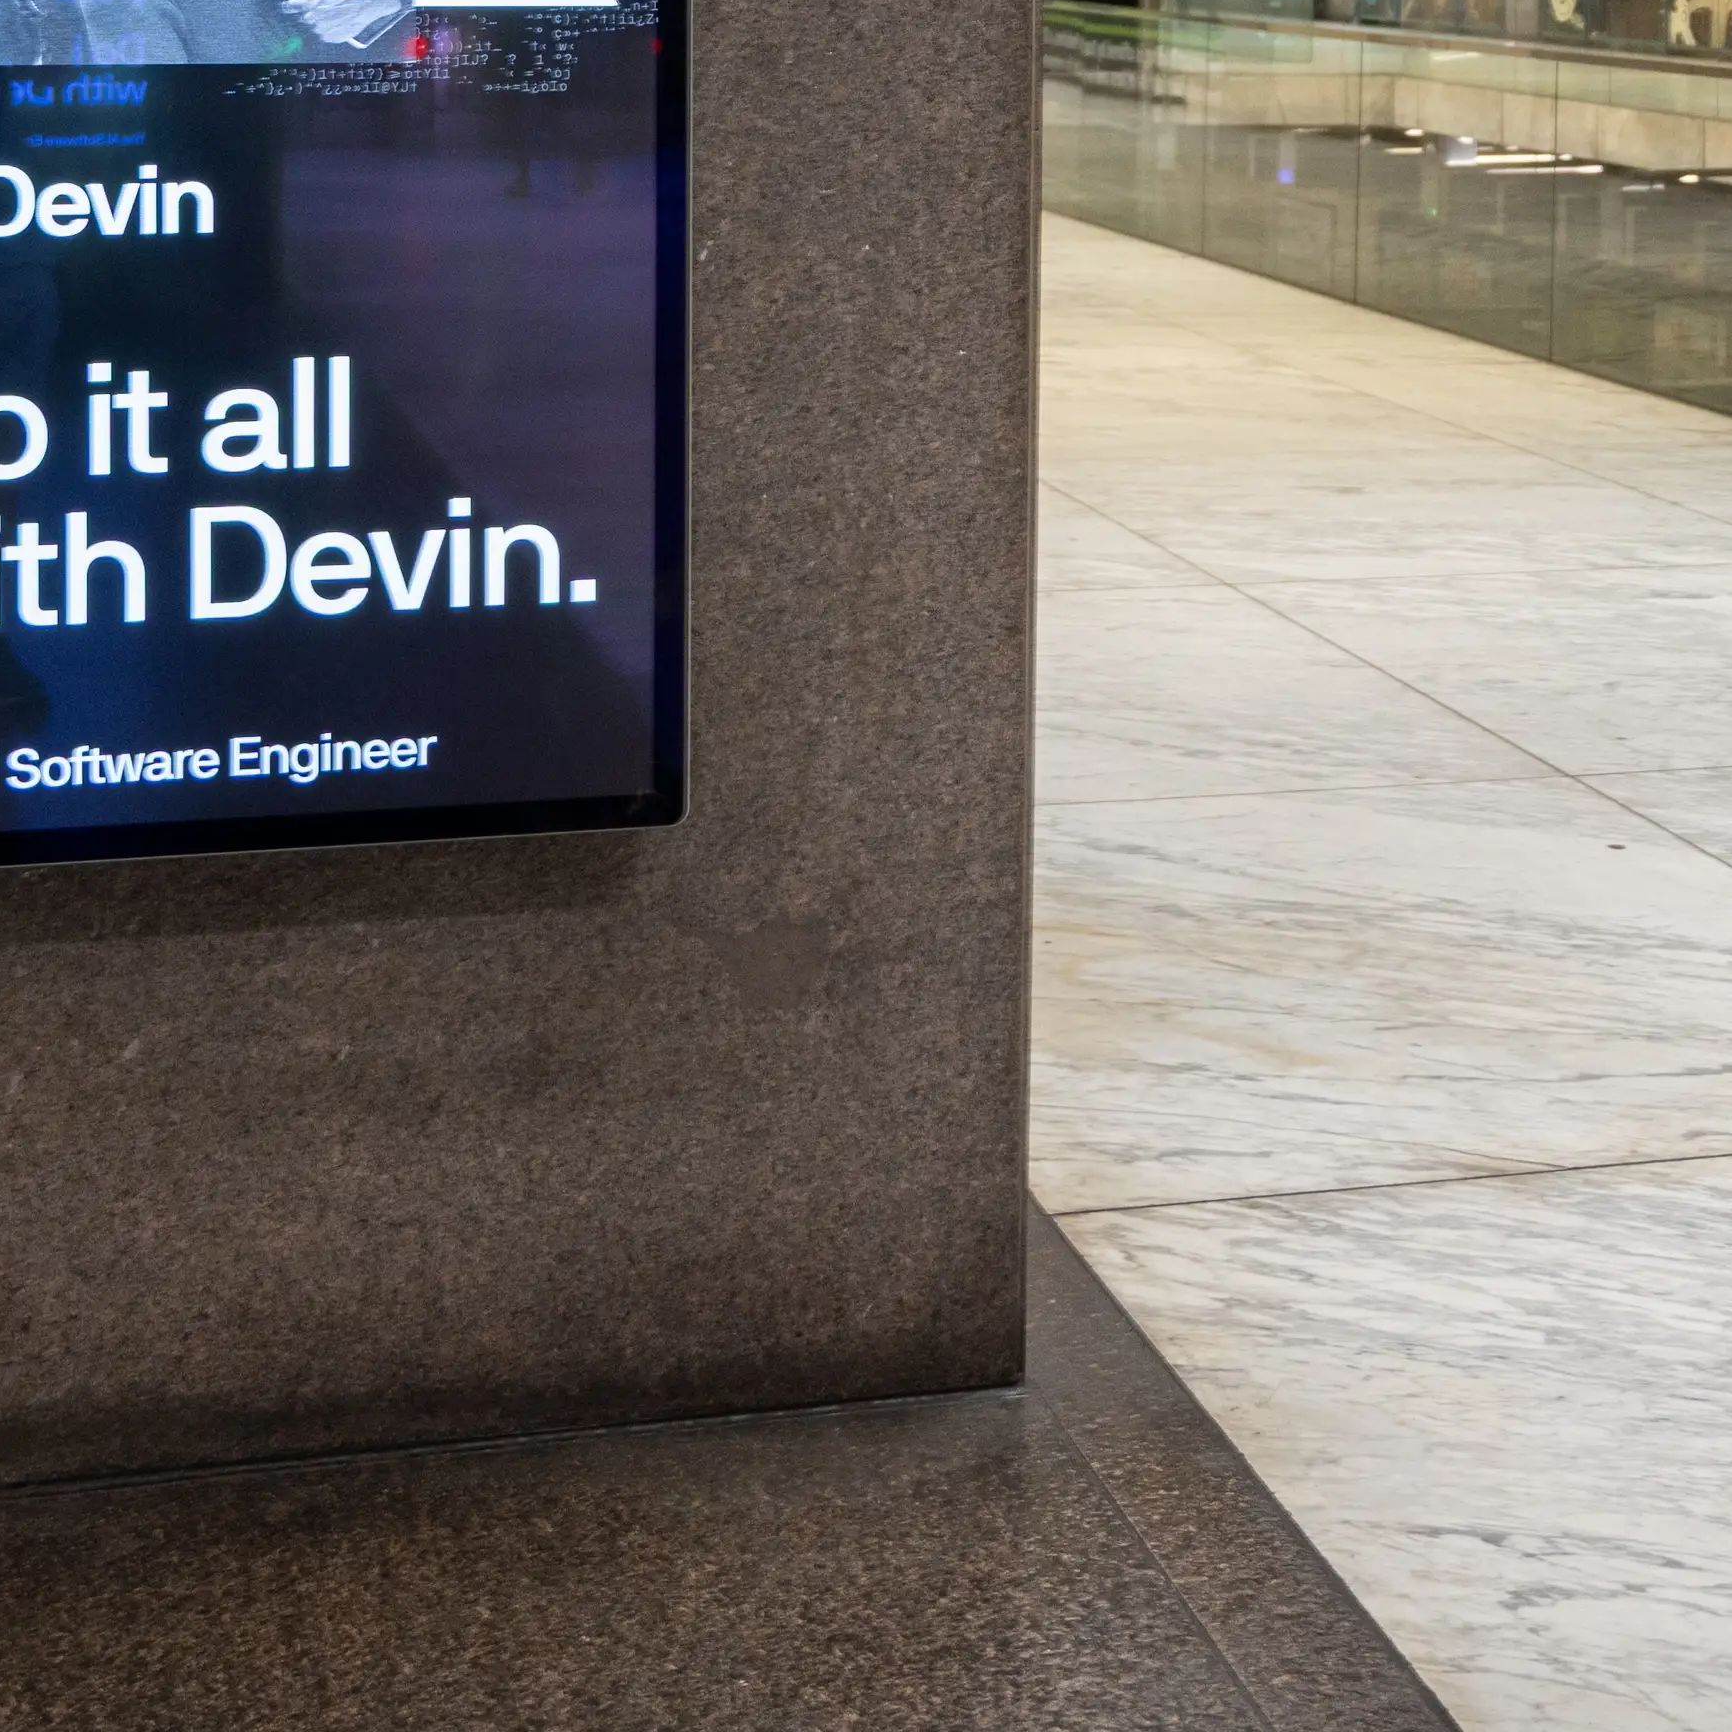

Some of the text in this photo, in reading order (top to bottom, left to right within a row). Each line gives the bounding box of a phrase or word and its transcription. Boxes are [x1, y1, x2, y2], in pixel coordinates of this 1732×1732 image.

[86, 361, 169, 477] it
[200, 354, 352, 474] all
[189, 497, 598, 622] Devin.
[5, 744, 220, 789] Software
[227, 731, 439, 785] Engineer
